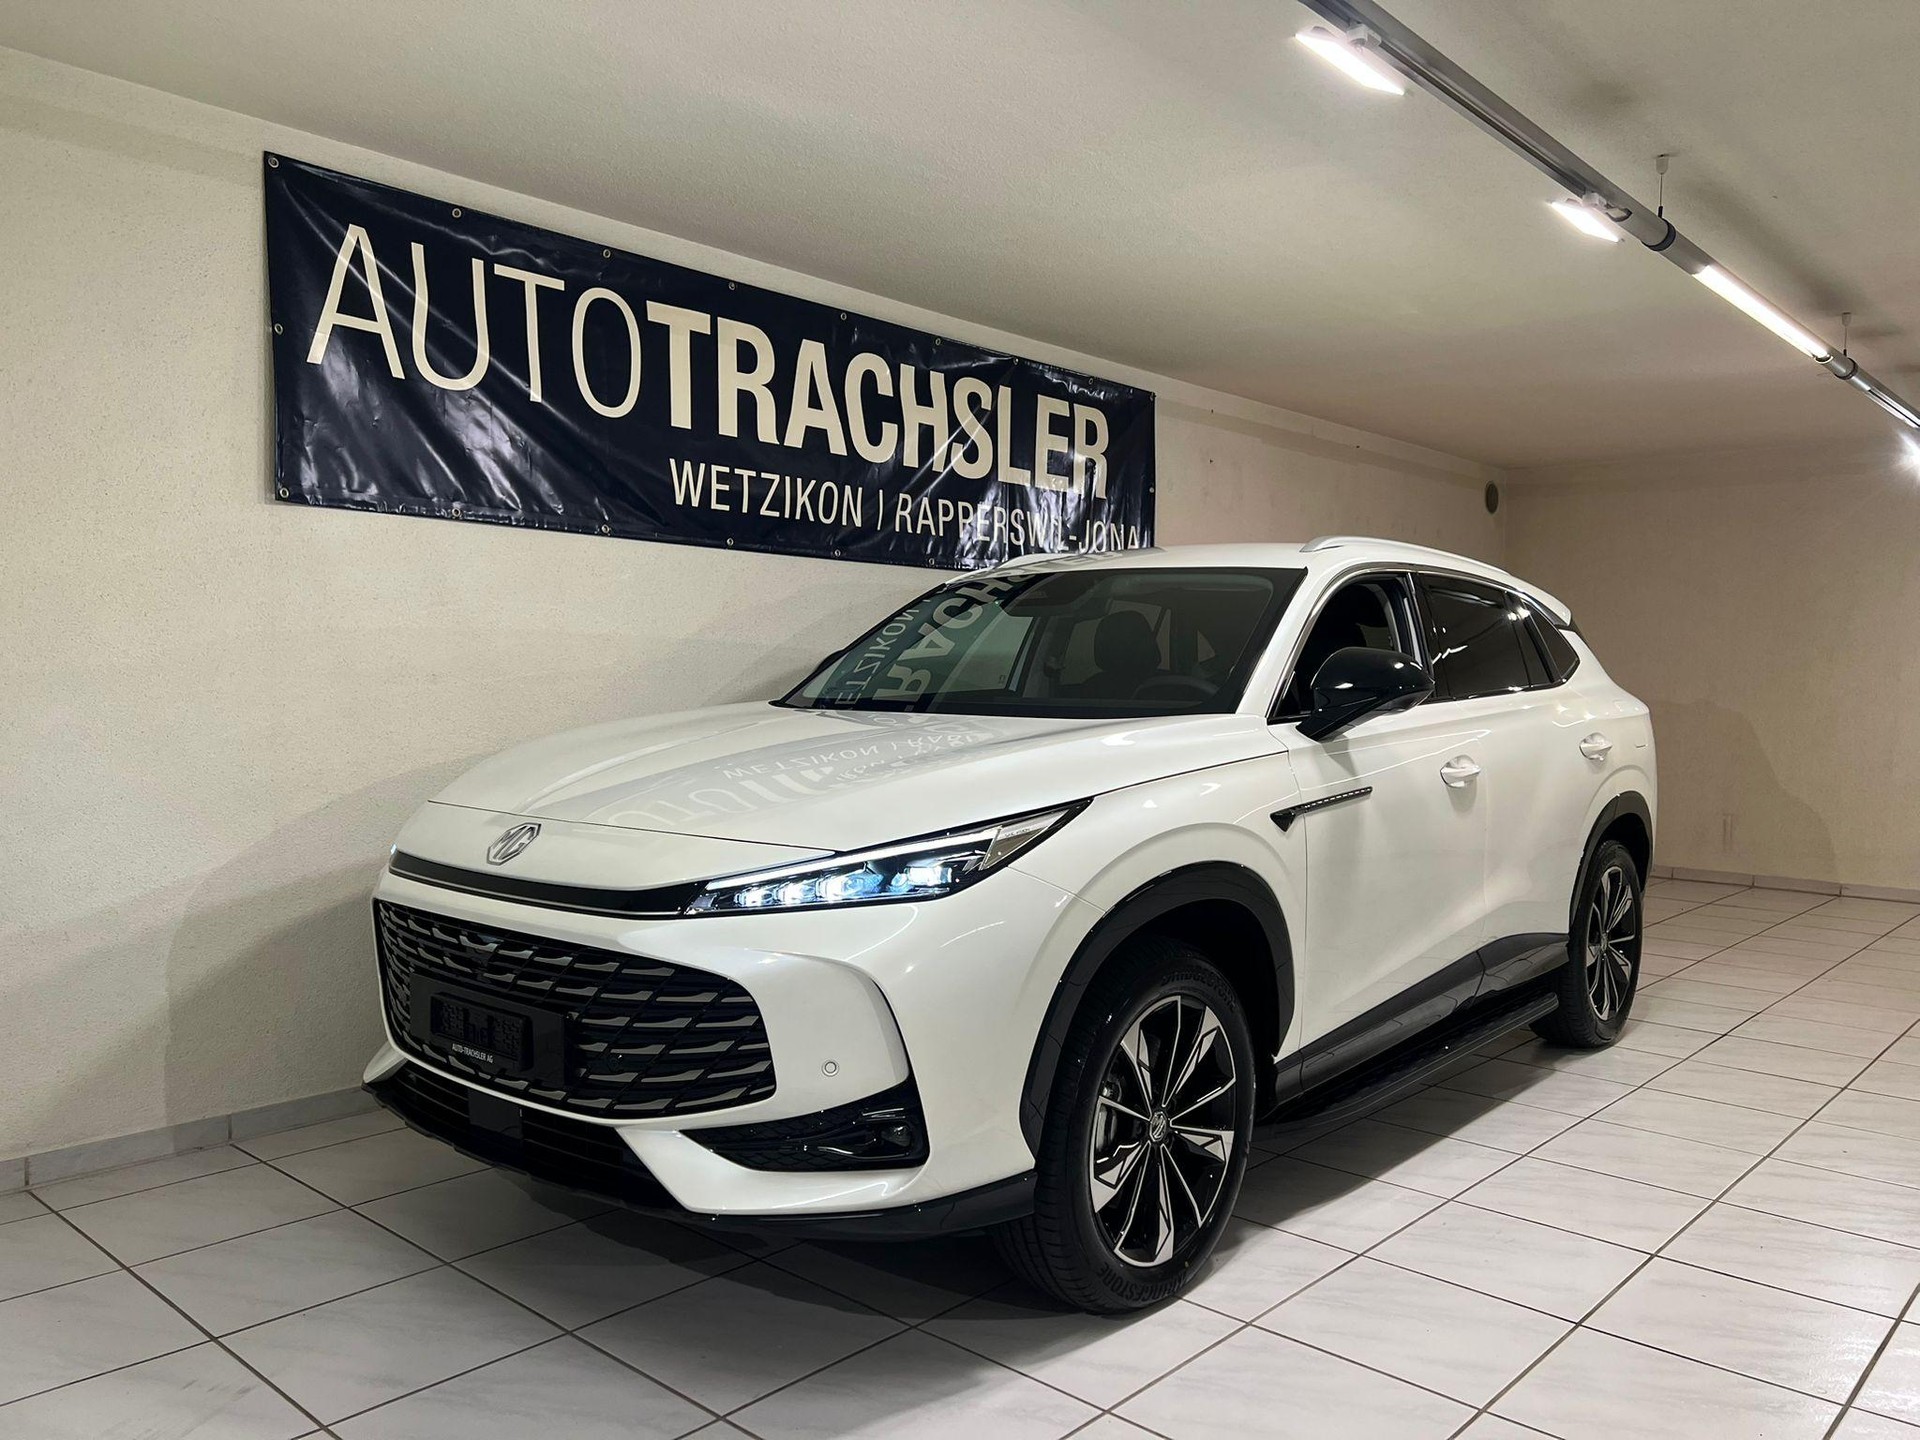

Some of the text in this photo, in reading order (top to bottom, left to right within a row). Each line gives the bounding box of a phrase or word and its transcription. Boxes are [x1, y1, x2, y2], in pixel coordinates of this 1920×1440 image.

[306, 223, 1111, 500] AUTOTRACHSLER
[669, 458, 864, 528] WETZIKON
[893, 493, 1140, 554] RAPPERSWIL-JONA
[487, 822, 541, 866] MG
